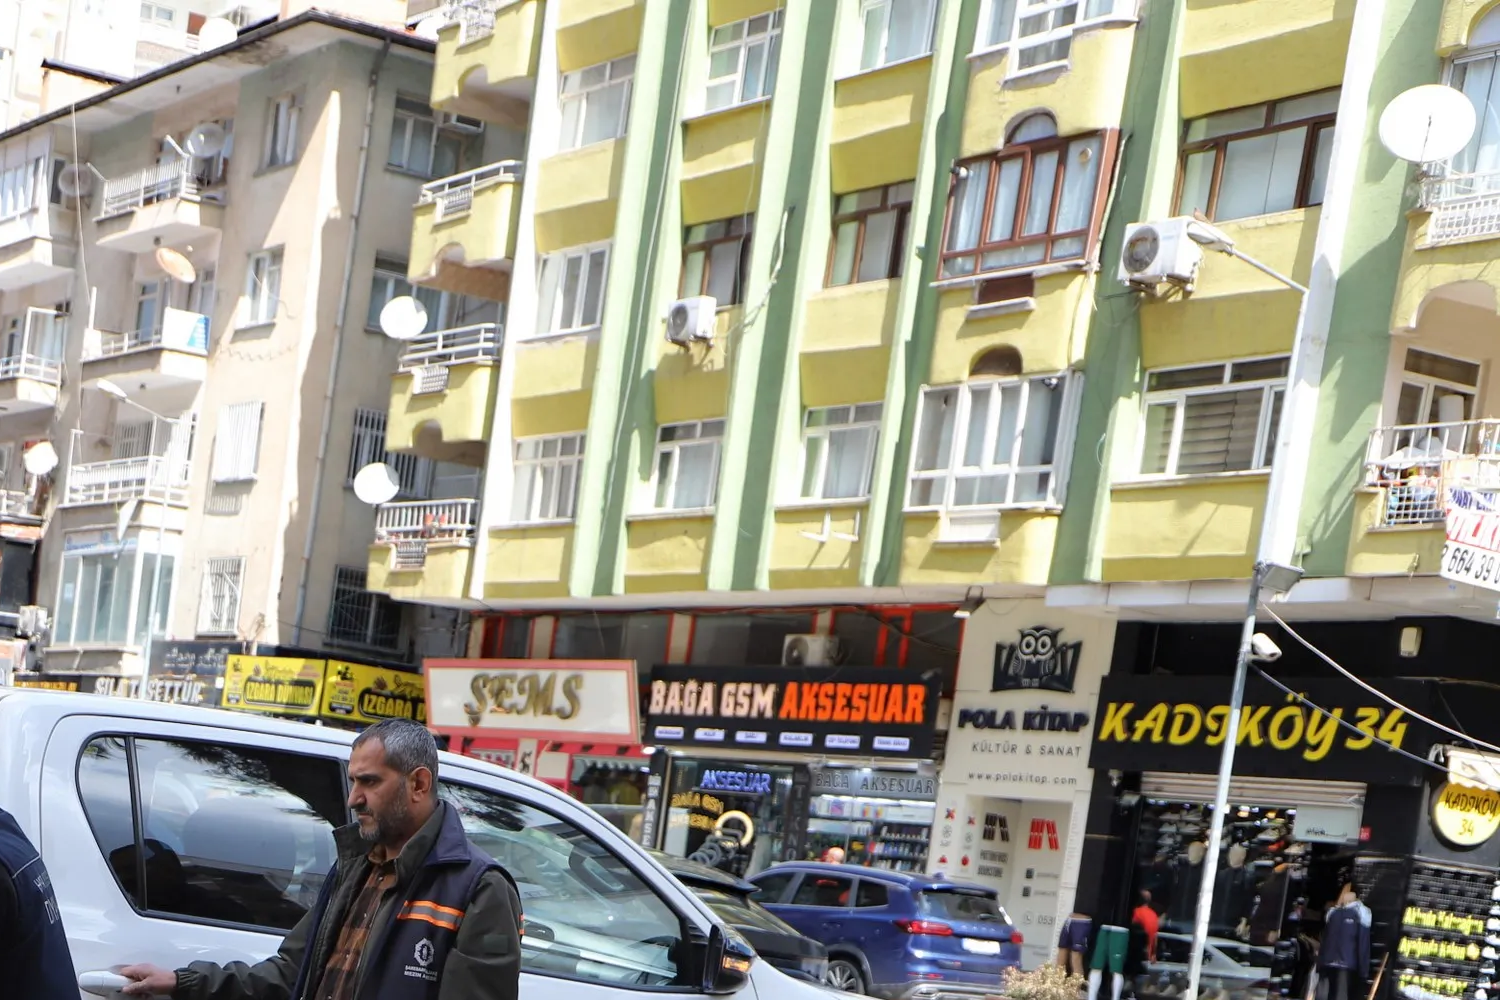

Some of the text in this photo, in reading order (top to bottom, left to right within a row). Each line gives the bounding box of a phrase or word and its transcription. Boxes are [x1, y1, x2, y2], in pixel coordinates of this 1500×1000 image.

[1447, 547, 1475, 576] 664
[1475, 554, 1495, 582] 39
[363, 693, 413, 720] IZGARA
[464, 671, 584, 726] ŞEMS
[649, 679, 928, 724] BAĞA GSM AKSESUAR
[958, 704, 1090, 733] POLA KİTAP
[1345, 706, 1408, 751] 34
[972, 740, 1082, 757] KÜLTÜR & SANAT
[860, 775, 935, 795] AKSESUAR
[1458, 818, 1474, 837] 34
